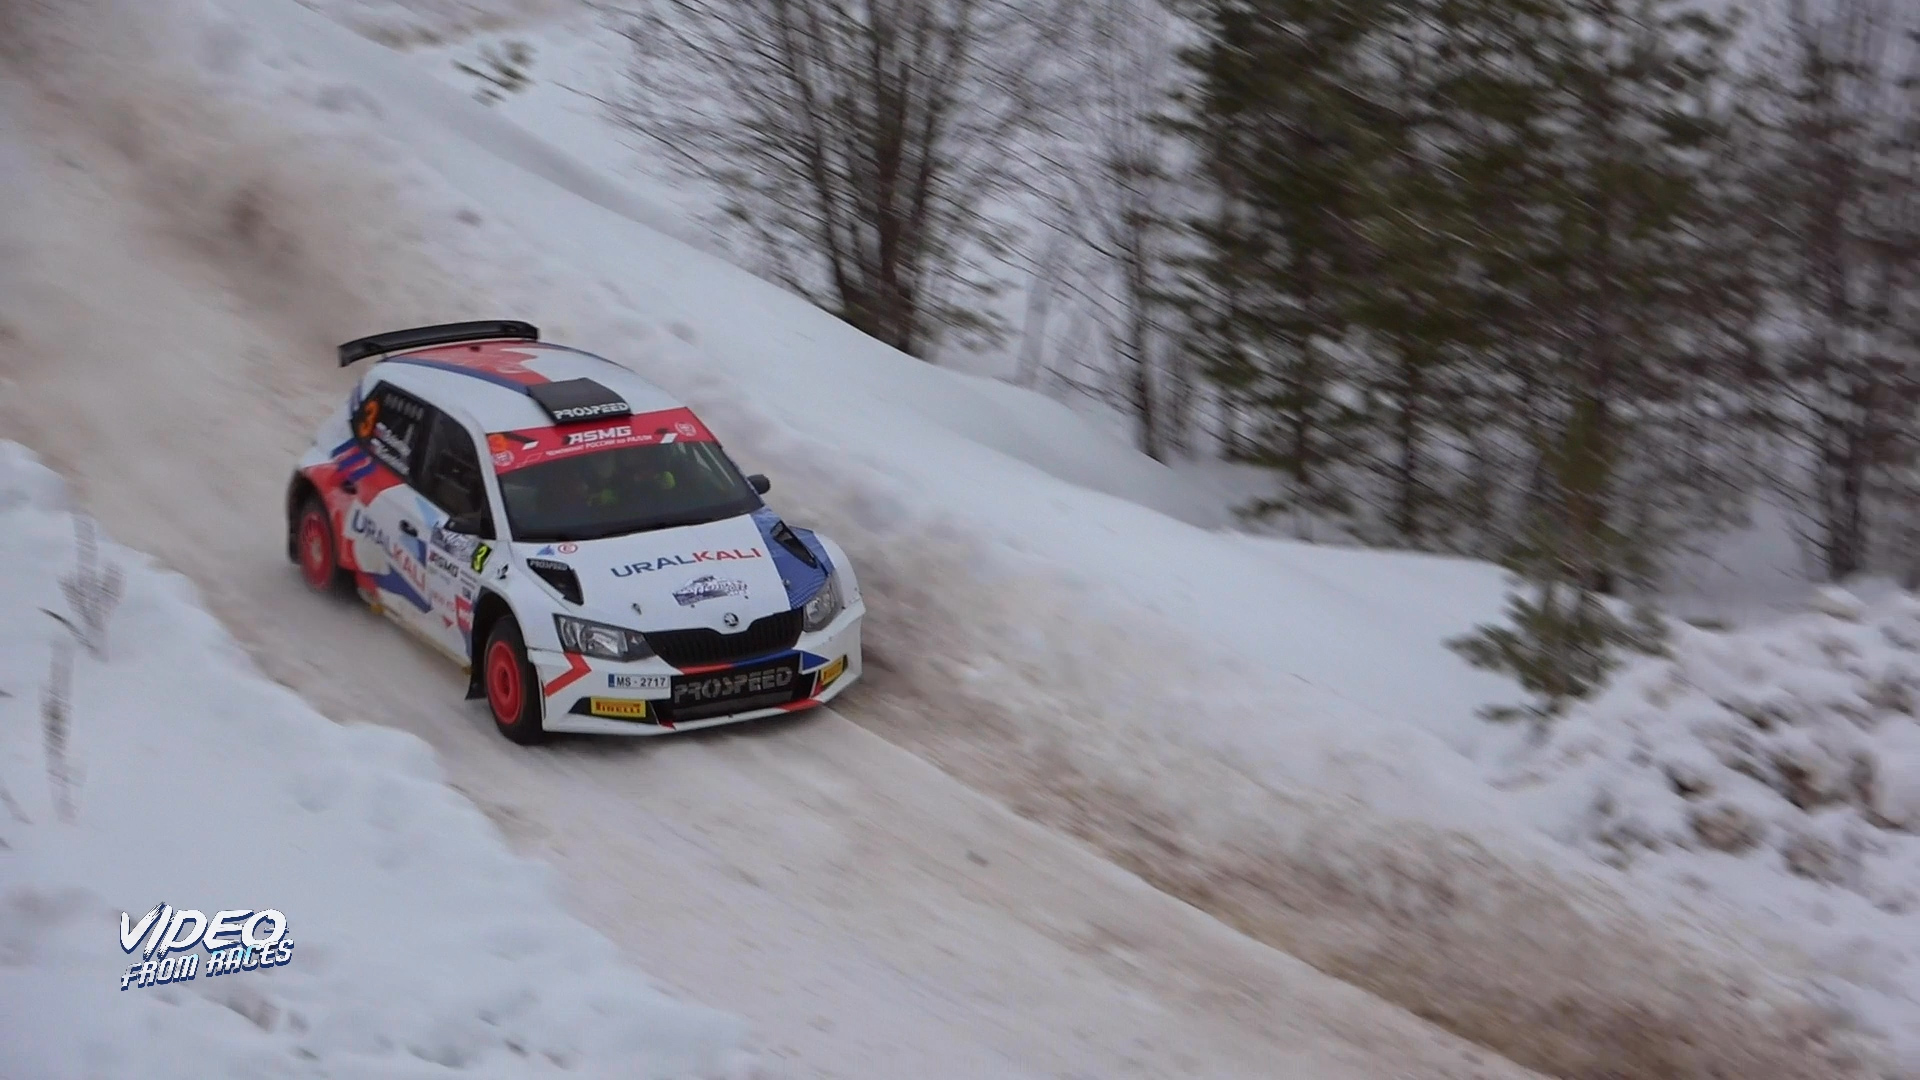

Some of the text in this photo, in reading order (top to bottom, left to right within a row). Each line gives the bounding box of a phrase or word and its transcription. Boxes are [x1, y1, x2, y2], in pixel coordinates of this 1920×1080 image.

[358, 399, 380, 439] 3
[553, 402, 630, 420] PROSPEED
[567, 425, 632, 446] ASMG
[352, 508, 427, 592] URALKALI
[611, 547, 762, 578] URALKALI
[616, 677, 632, 687] MS
[640, 677, 666, 688] 2717
[673, 666, 793, 704] PROSPEED
[595, 701, 641, 714] PIRELLI
